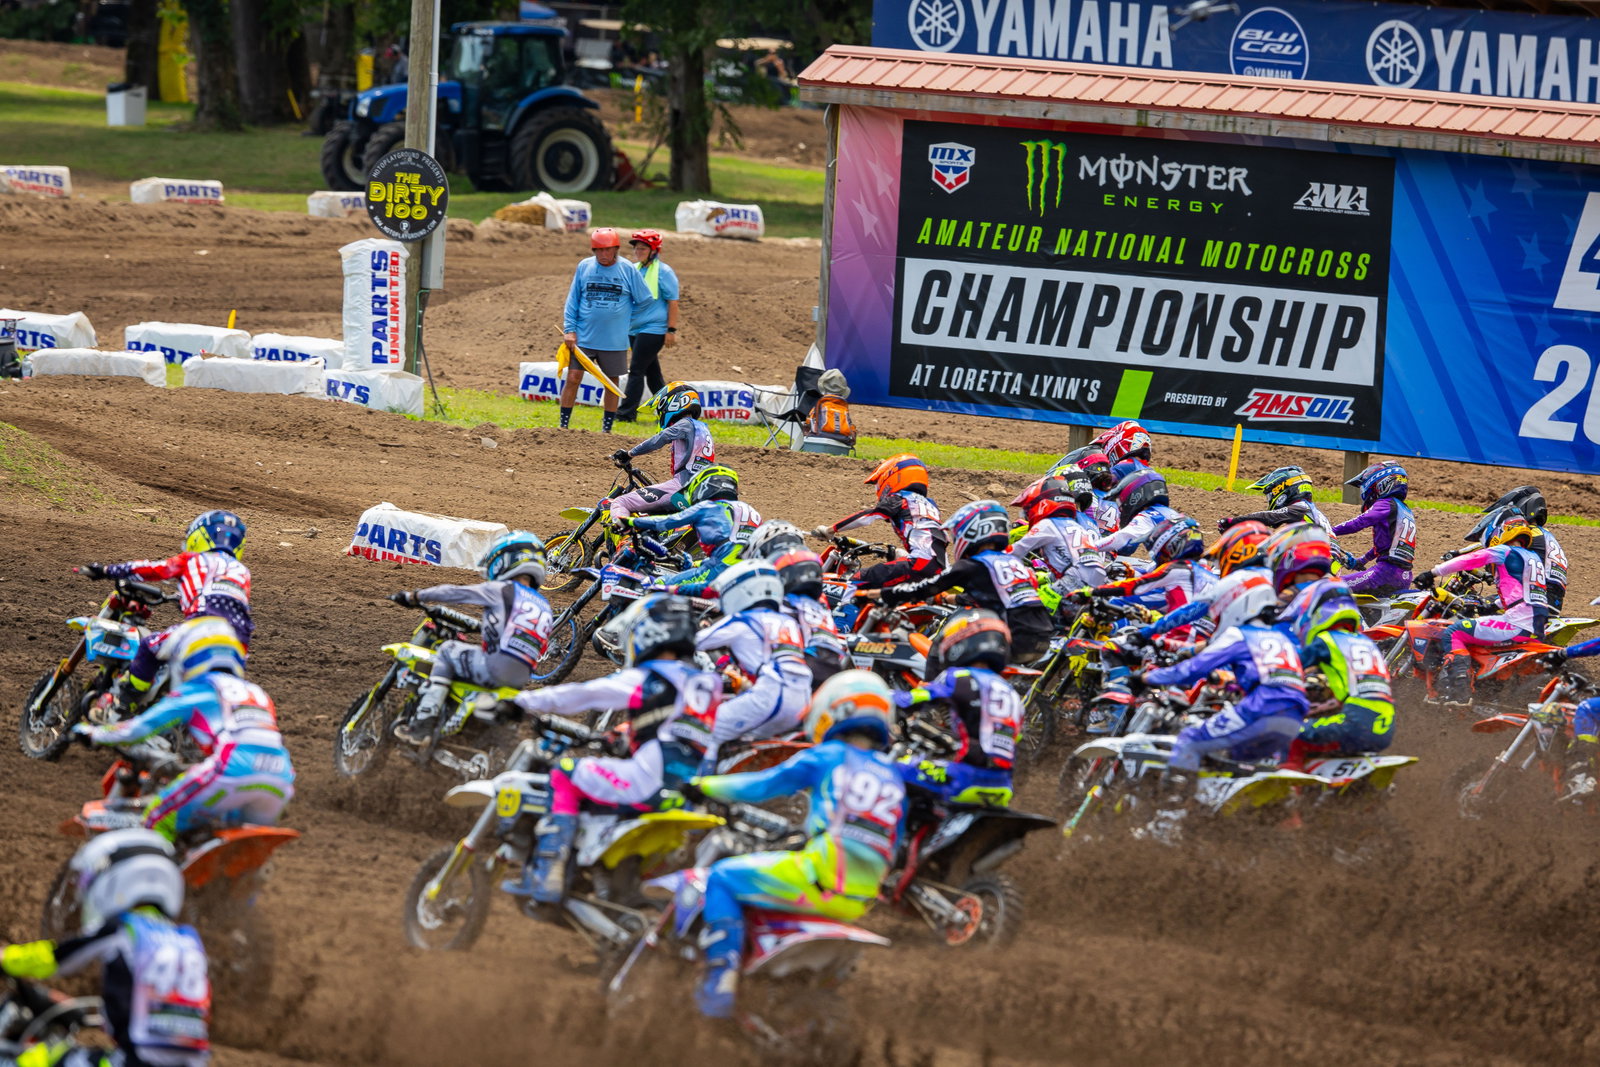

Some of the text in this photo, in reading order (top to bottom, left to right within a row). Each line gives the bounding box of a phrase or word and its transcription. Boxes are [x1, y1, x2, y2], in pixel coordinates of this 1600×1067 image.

[970, 0, 1173, 68] YAMAHA
[1238, 28, 1299, 43] BLU
[1240, 41, 1302, 56] CRU
[395, 171, 421, 184] THE
[1078, 152, 1253, 197] MONSTER
[165, 184, 221, 198] PARTS
[369, 181, 445, 206] DIRTY
[1104, 194, 1225, 215] ENERGY
[1293, 182, 1370, 212] AMA
[385, 202, 428, 220] 100
[916, 217, 1373, 281] AMATEUR NATIONAL MOTOCROSS
[371, 250, 389, 365] PARTS
[389, 251, 400, 365] UNLIMITED
[911, 268, 1367, 372] CHAMPIONSHIP
[326, 378, 371, 404] RTS
[909, 363, 1102, 403] AT LORETTA LYNN'S
[1518, 344, 1600, 446] 2
[1164, 392, 1228, 408] PRESENTED BY
[1243, 391, 1351, 421] AMSOIL
[354, 522, 442, 565] PARTS
[1401, 516, 1417, 544] 17
[993, 559, 1031, 586] 63
[1528, 558, 1547, 586] 13
[1260, 637, 1298, 667] 21
[1352, 646, 1387, 676] 51
